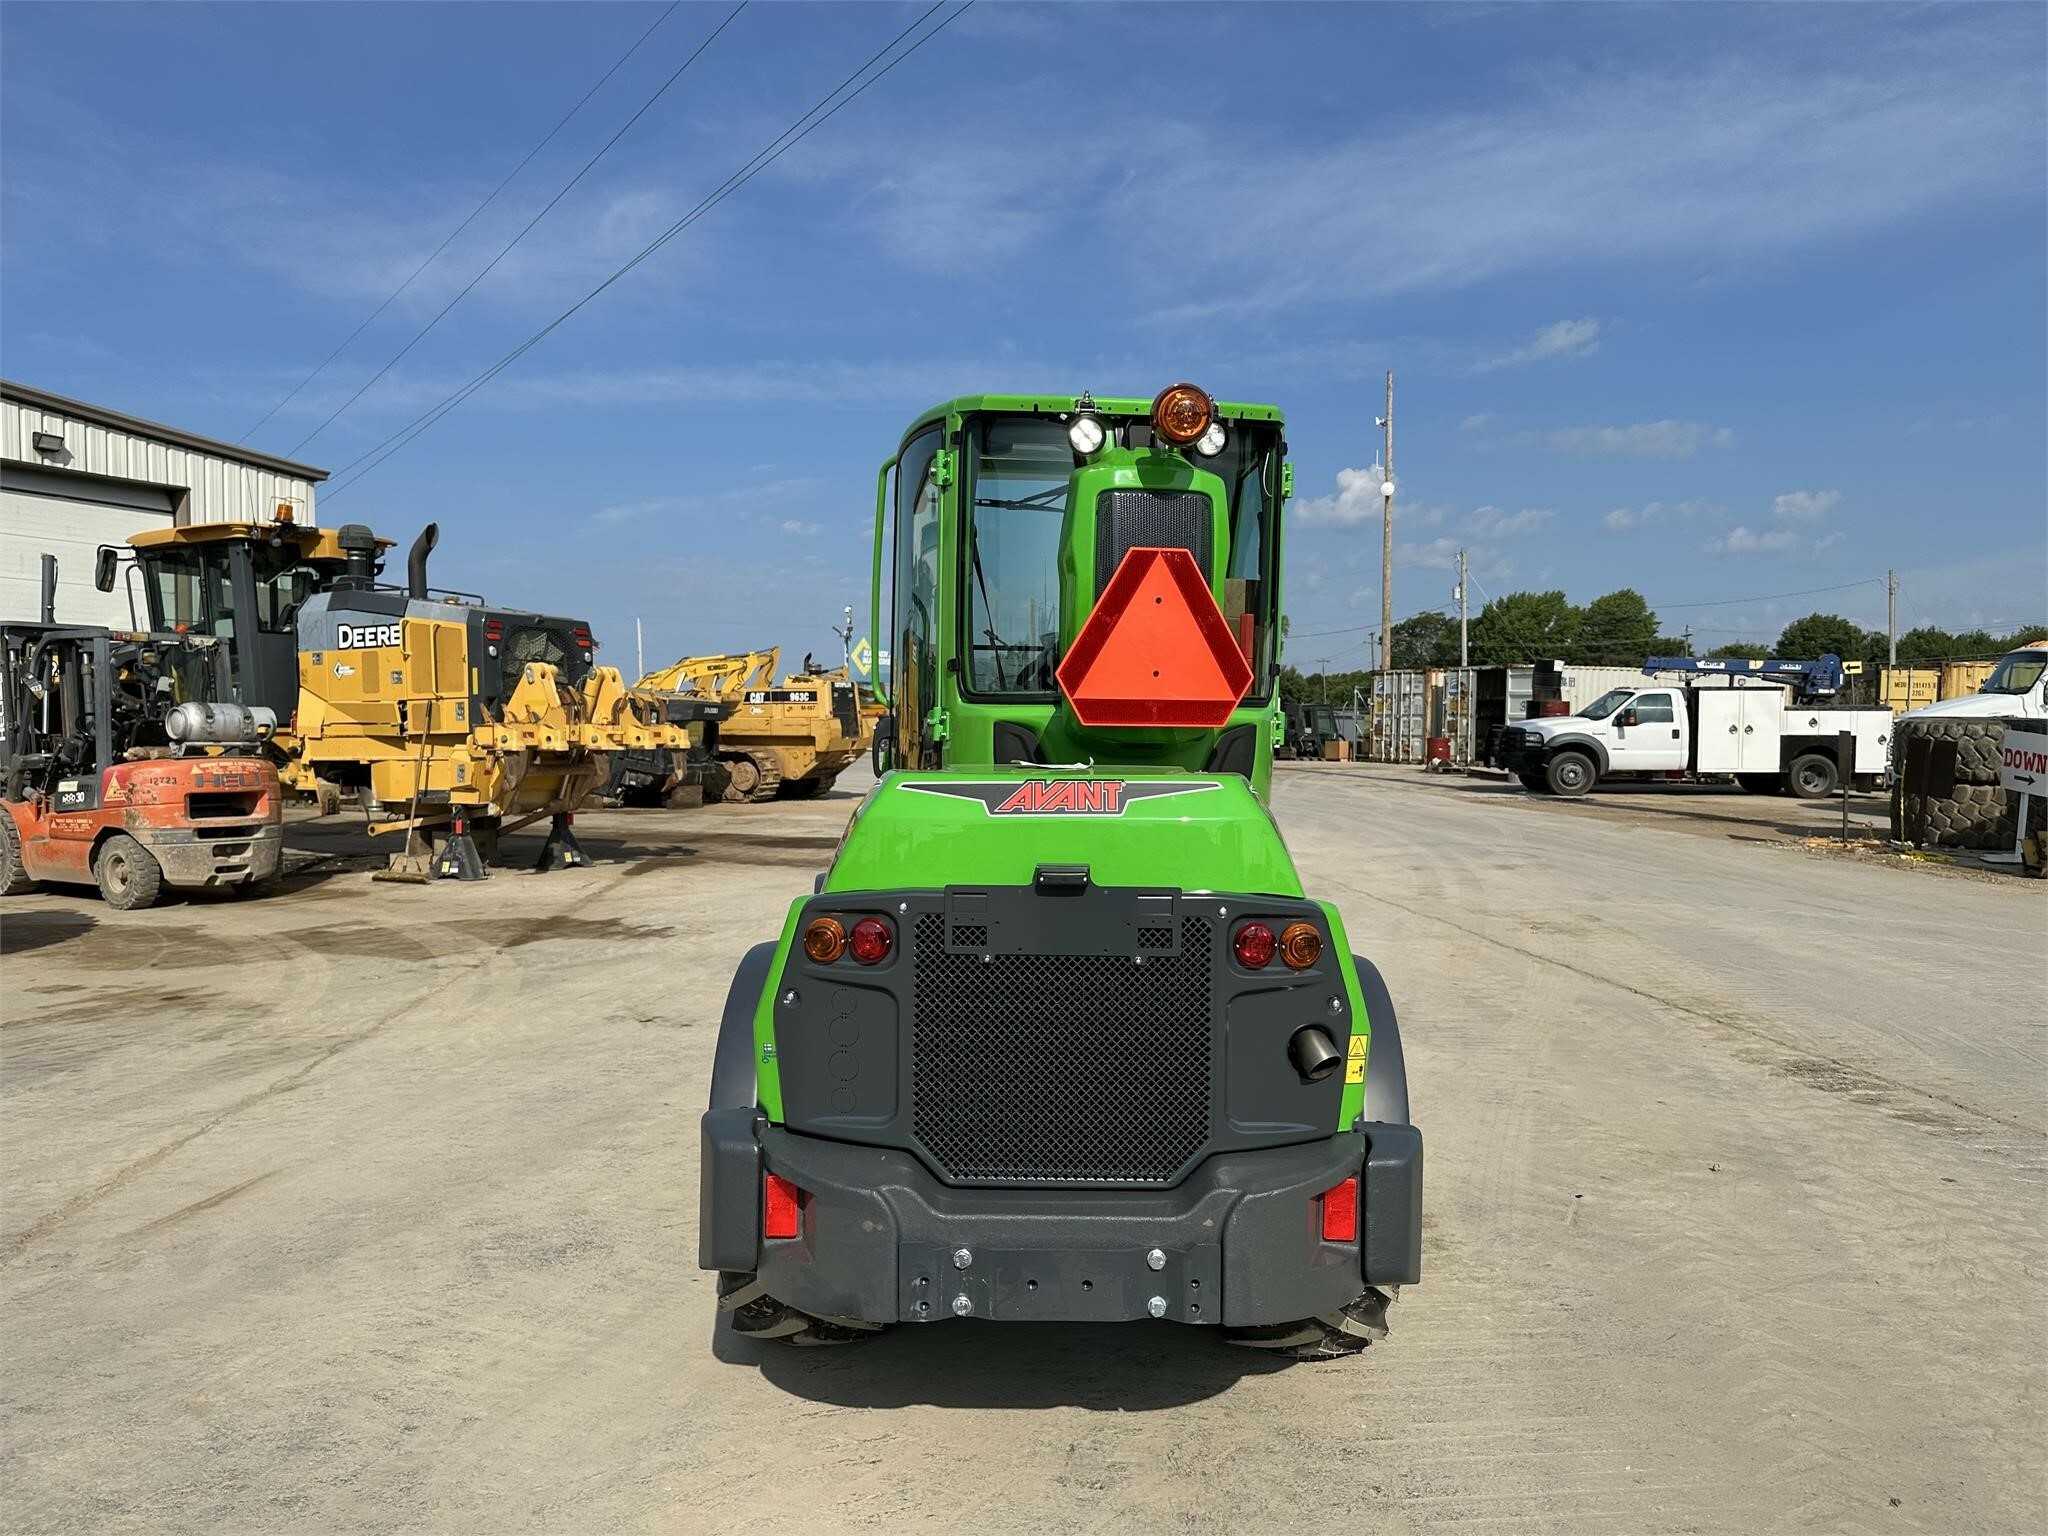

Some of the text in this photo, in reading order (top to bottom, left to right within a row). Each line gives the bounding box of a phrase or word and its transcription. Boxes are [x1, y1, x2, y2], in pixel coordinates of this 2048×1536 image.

[338, 624, 400, 650] DEERE
[750, 692, 765, 704] CAT
[789, 692, 810, 702] 963C
[2003, 747, 2048, 775] DOWN
[994, 780, 1123, 812] AVANT
